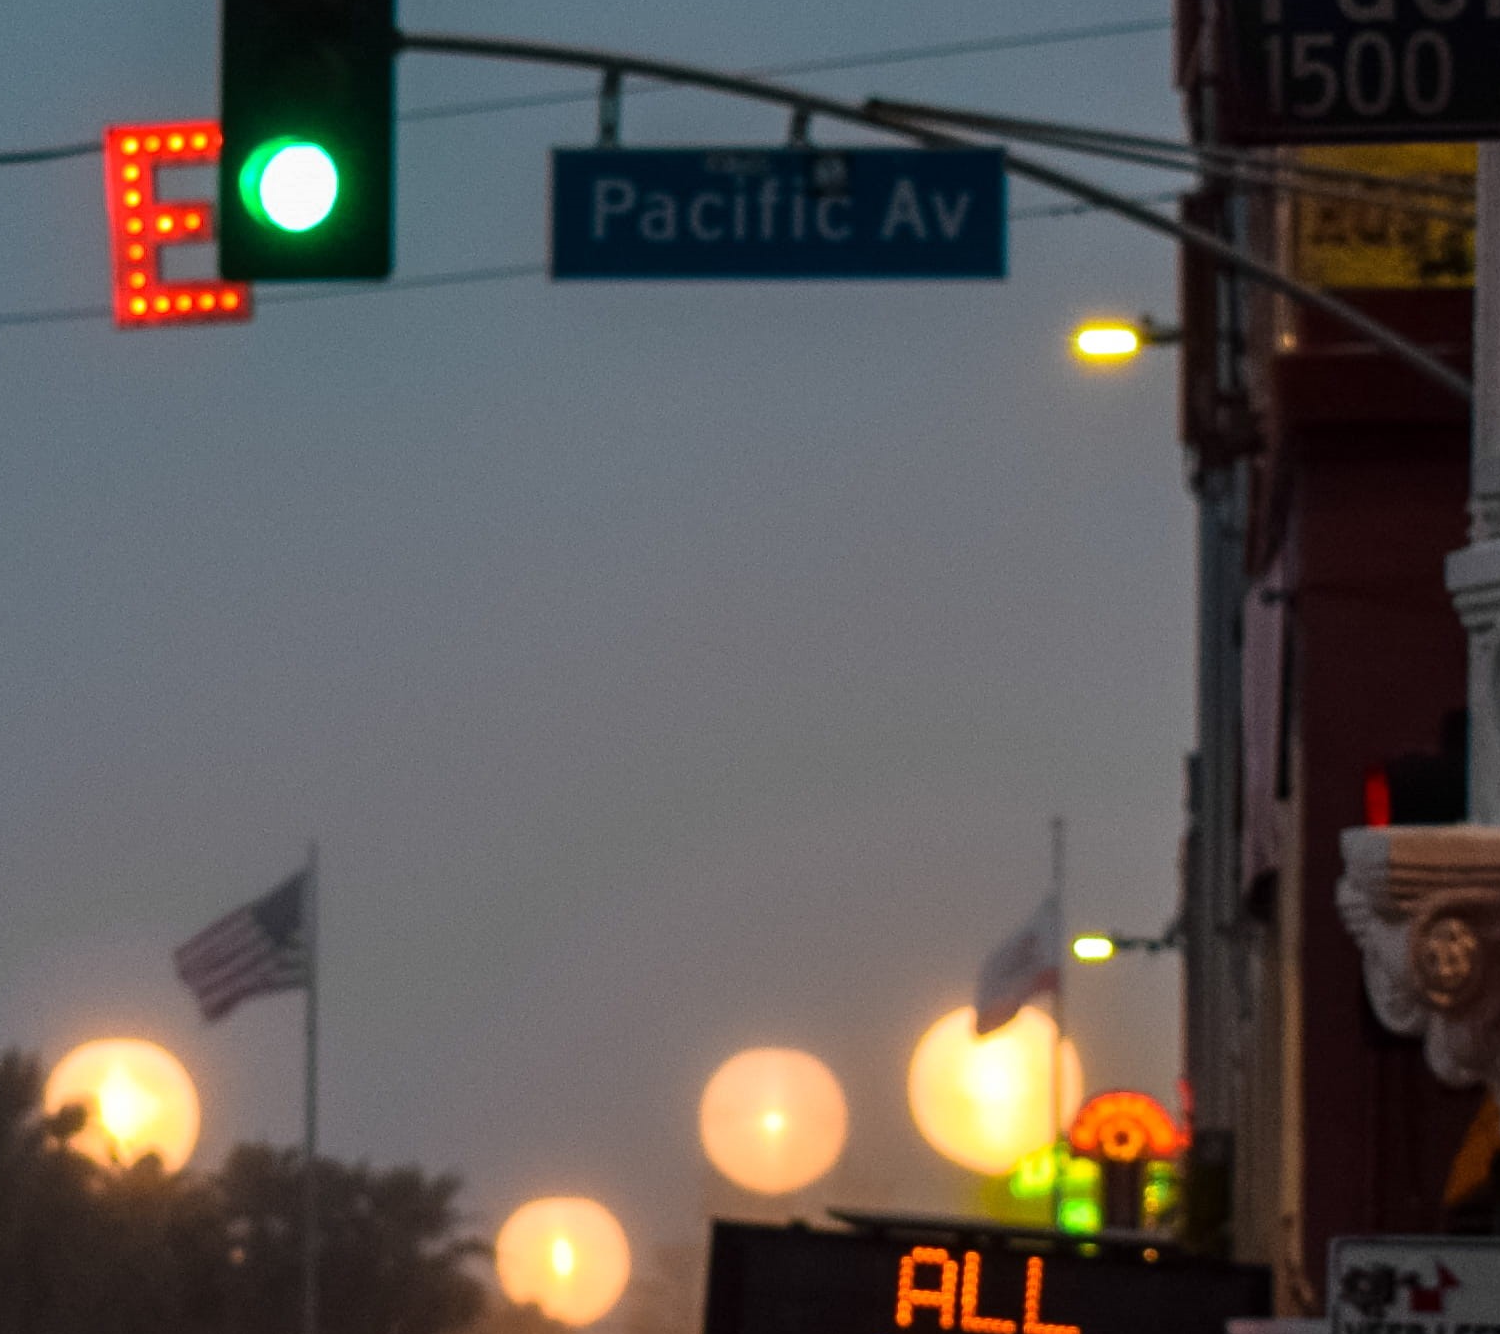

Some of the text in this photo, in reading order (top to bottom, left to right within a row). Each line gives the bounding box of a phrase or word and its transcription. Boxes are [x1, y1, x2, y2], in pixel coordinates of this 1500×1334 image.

[1263, 28, 1456, 116] 1500
[590, 176, 972, 243] Pacific Av
